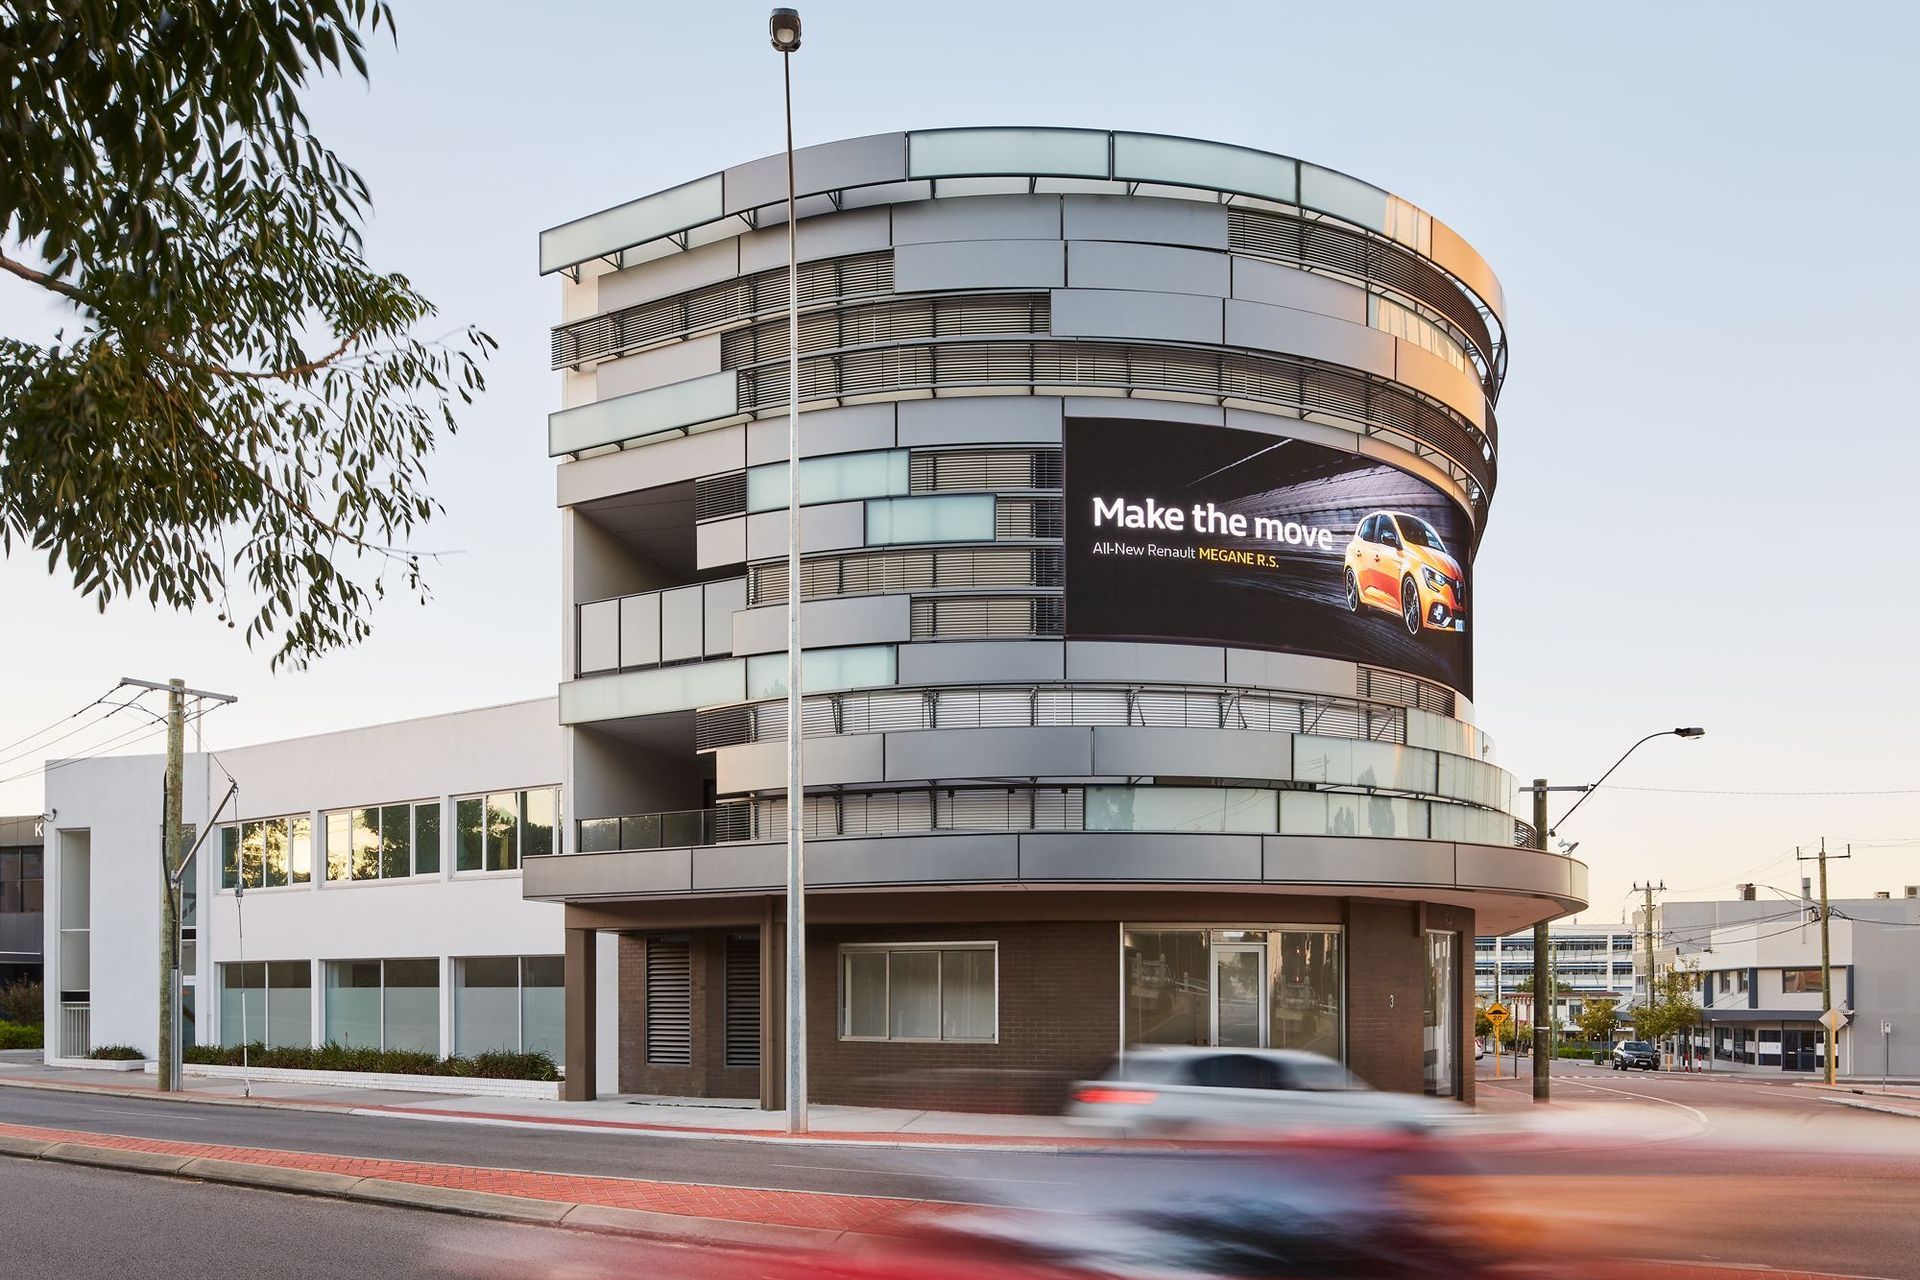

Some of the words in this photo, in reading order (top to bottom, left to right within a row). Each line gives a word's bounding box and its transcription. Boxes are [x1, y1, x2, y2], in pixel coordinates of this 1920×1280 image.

[1093, 498, 1184, 531] Make
[1192, 503, 1247, 537] the
[1254, 516, 1333, 551] move
[1093, 541, 1144, 556] All-New
[1148, 544, 1195, 559] Renault
[1199, 547, 1254, 565] MEGANE
[1257, 554, 1280, 568] R.S.
[1389, 994, 1394, 1008] 3
